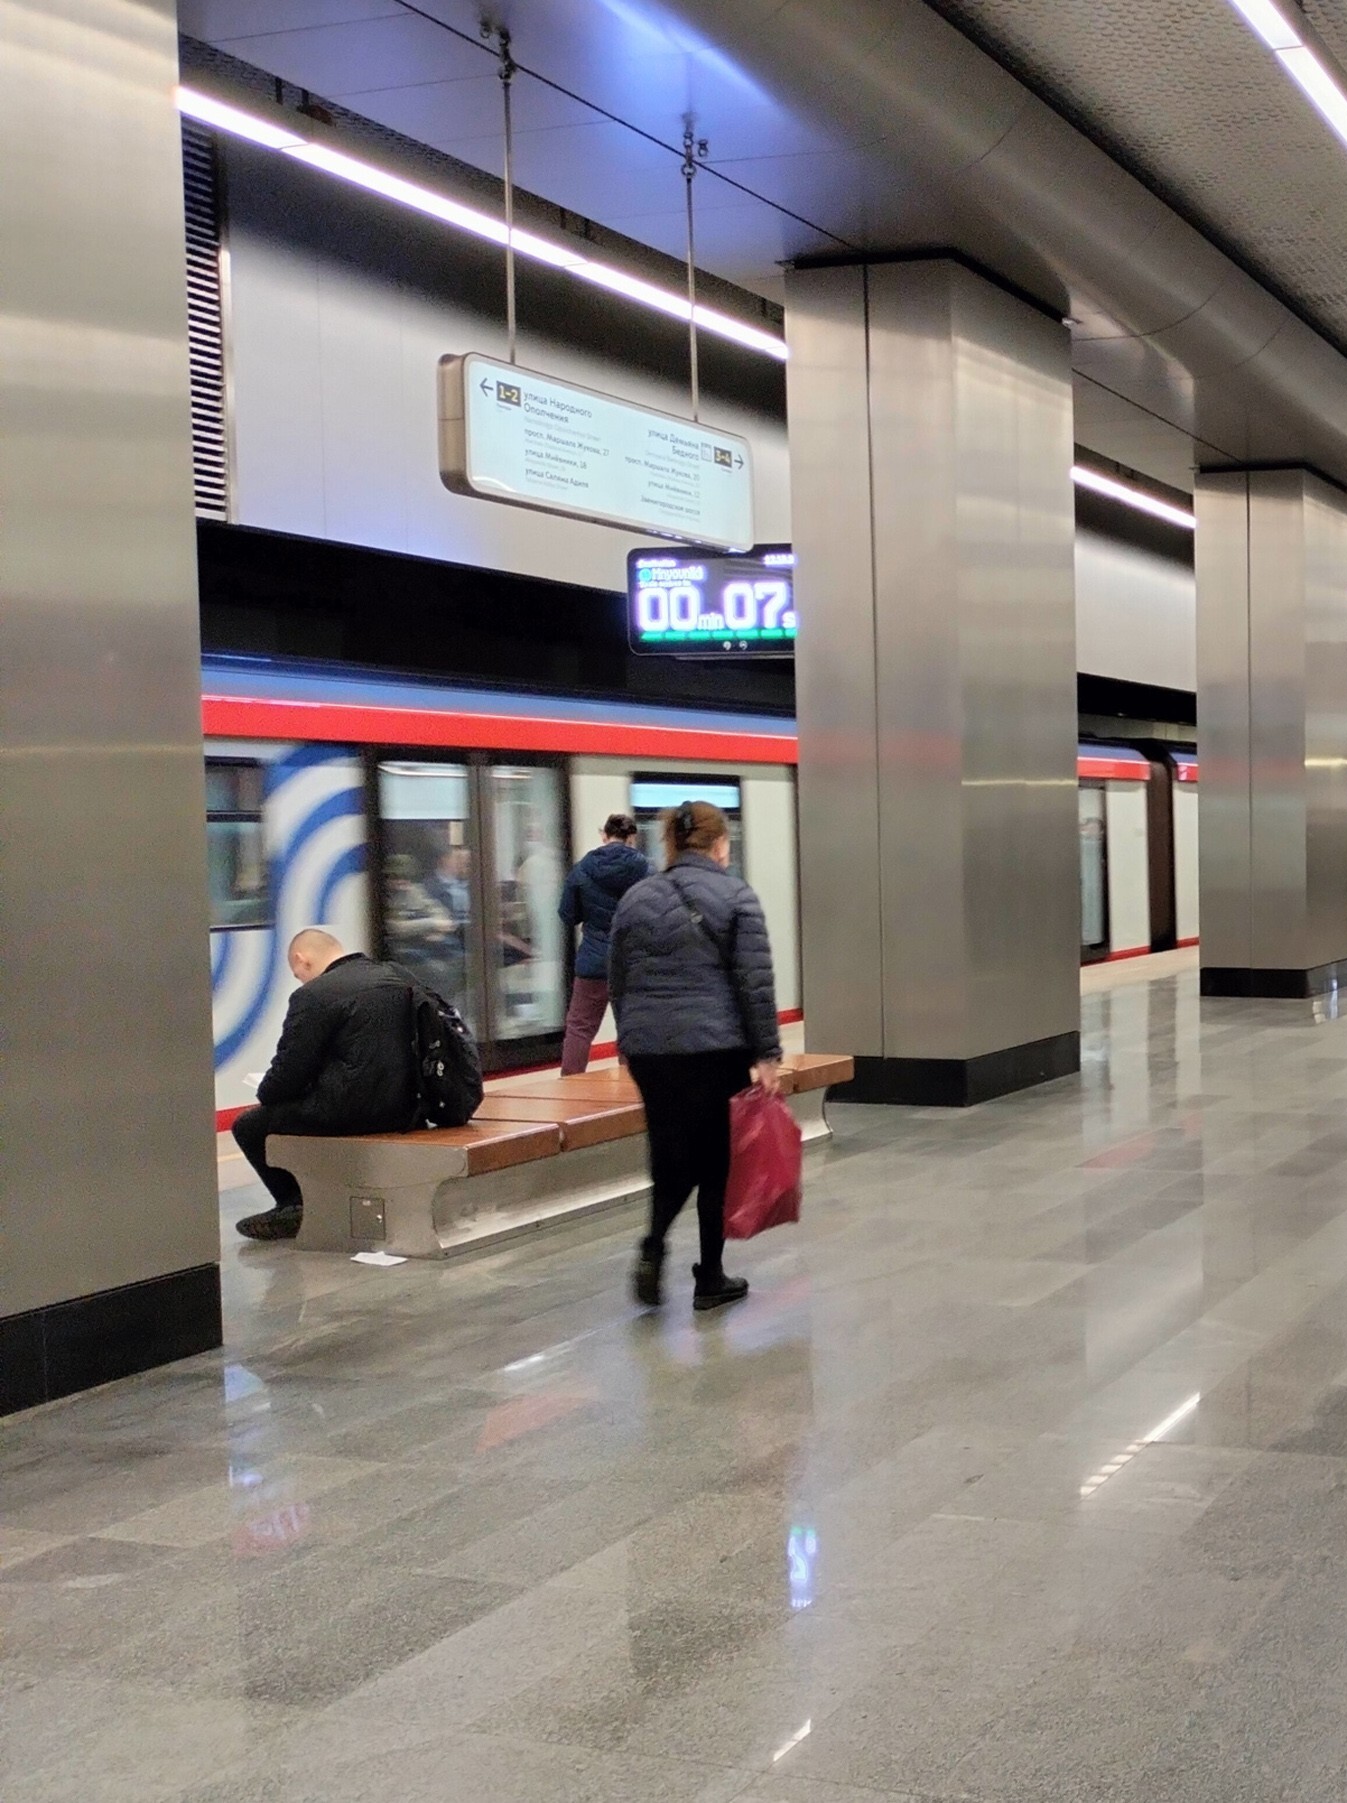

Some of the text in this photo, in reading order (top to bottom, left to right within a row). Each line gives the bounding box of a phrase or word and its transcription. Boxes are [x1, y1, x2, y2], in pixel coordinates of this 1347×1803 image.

[523, 391, 593, 419] улица Народного
[523, 402, 570, 425] Ополчения
[638, 586, 699, 632] 00
[698, 612, 724, 630] min
[724, 581, 788, 630] 07
